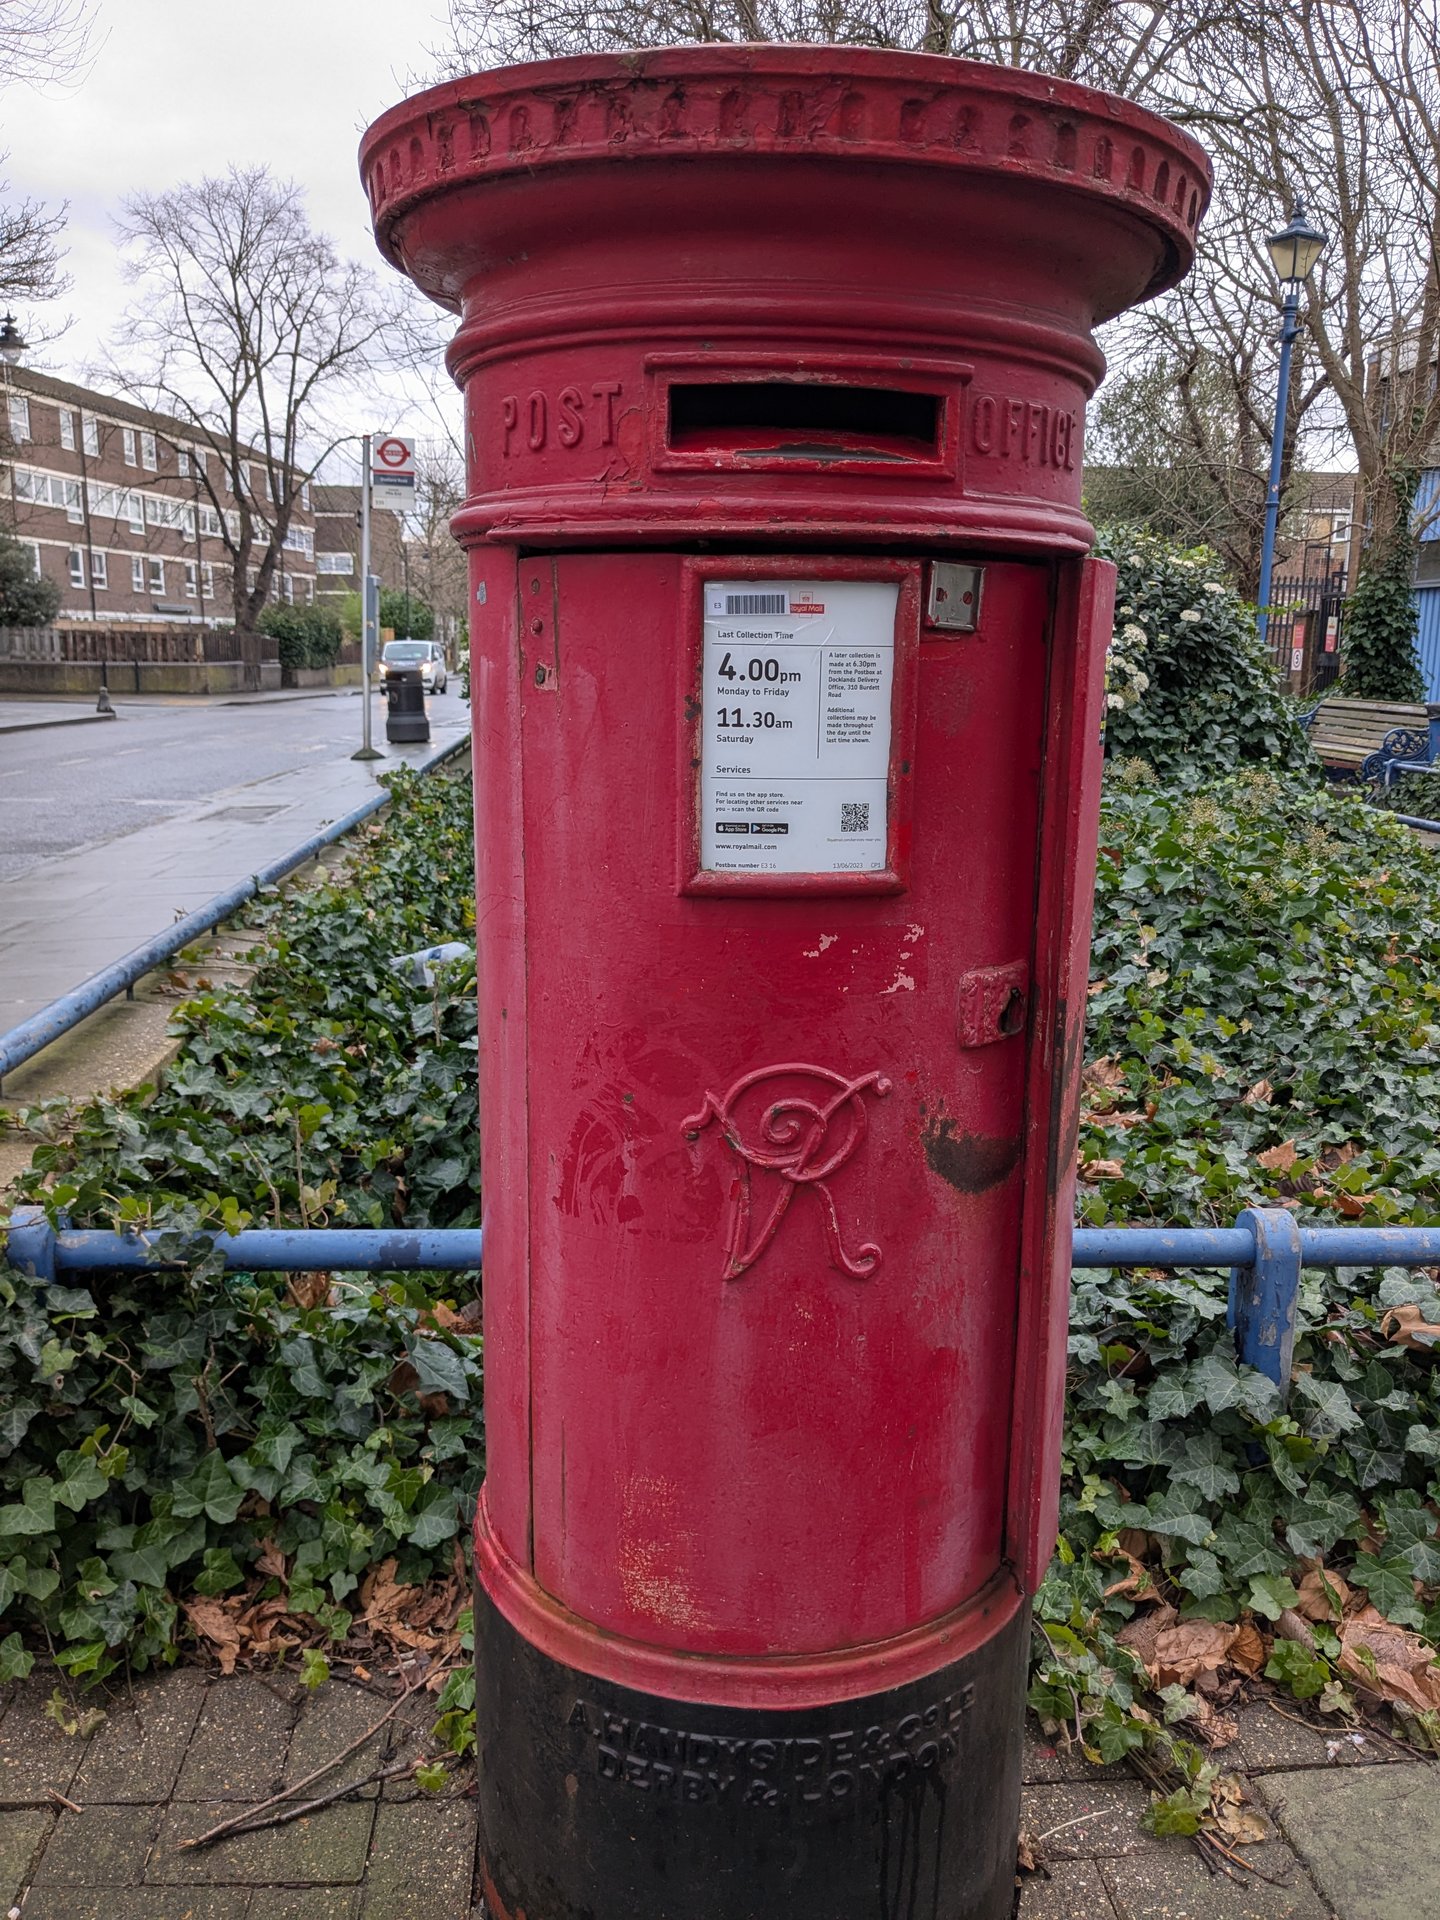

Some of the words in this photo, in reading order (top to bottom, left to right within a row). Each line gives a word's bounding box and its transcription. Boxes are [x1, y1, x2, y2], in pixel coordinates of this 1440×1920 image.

[501, 381, 622, 458] POST
[974, 395, 1075, 472] OFFICE
[790, 605, 808, 613] Royal
[808, 605, 823, 613] Mail
[736, 631, 773, 639] Collection
[774, 631, 794, 639] Time
[718, 652, 801, 684] 4.00pm
[717, 687, 750, 698] Monday
[752, 688, 761, 696] to
[763, 687, 790, 698] Friday
[717, 707, 793, 728] 11.30am
[716, 734, 754, 745] Saturday
[716, 765, 751, 774] Services
[597, 1743, 736, 1803] DERBY
